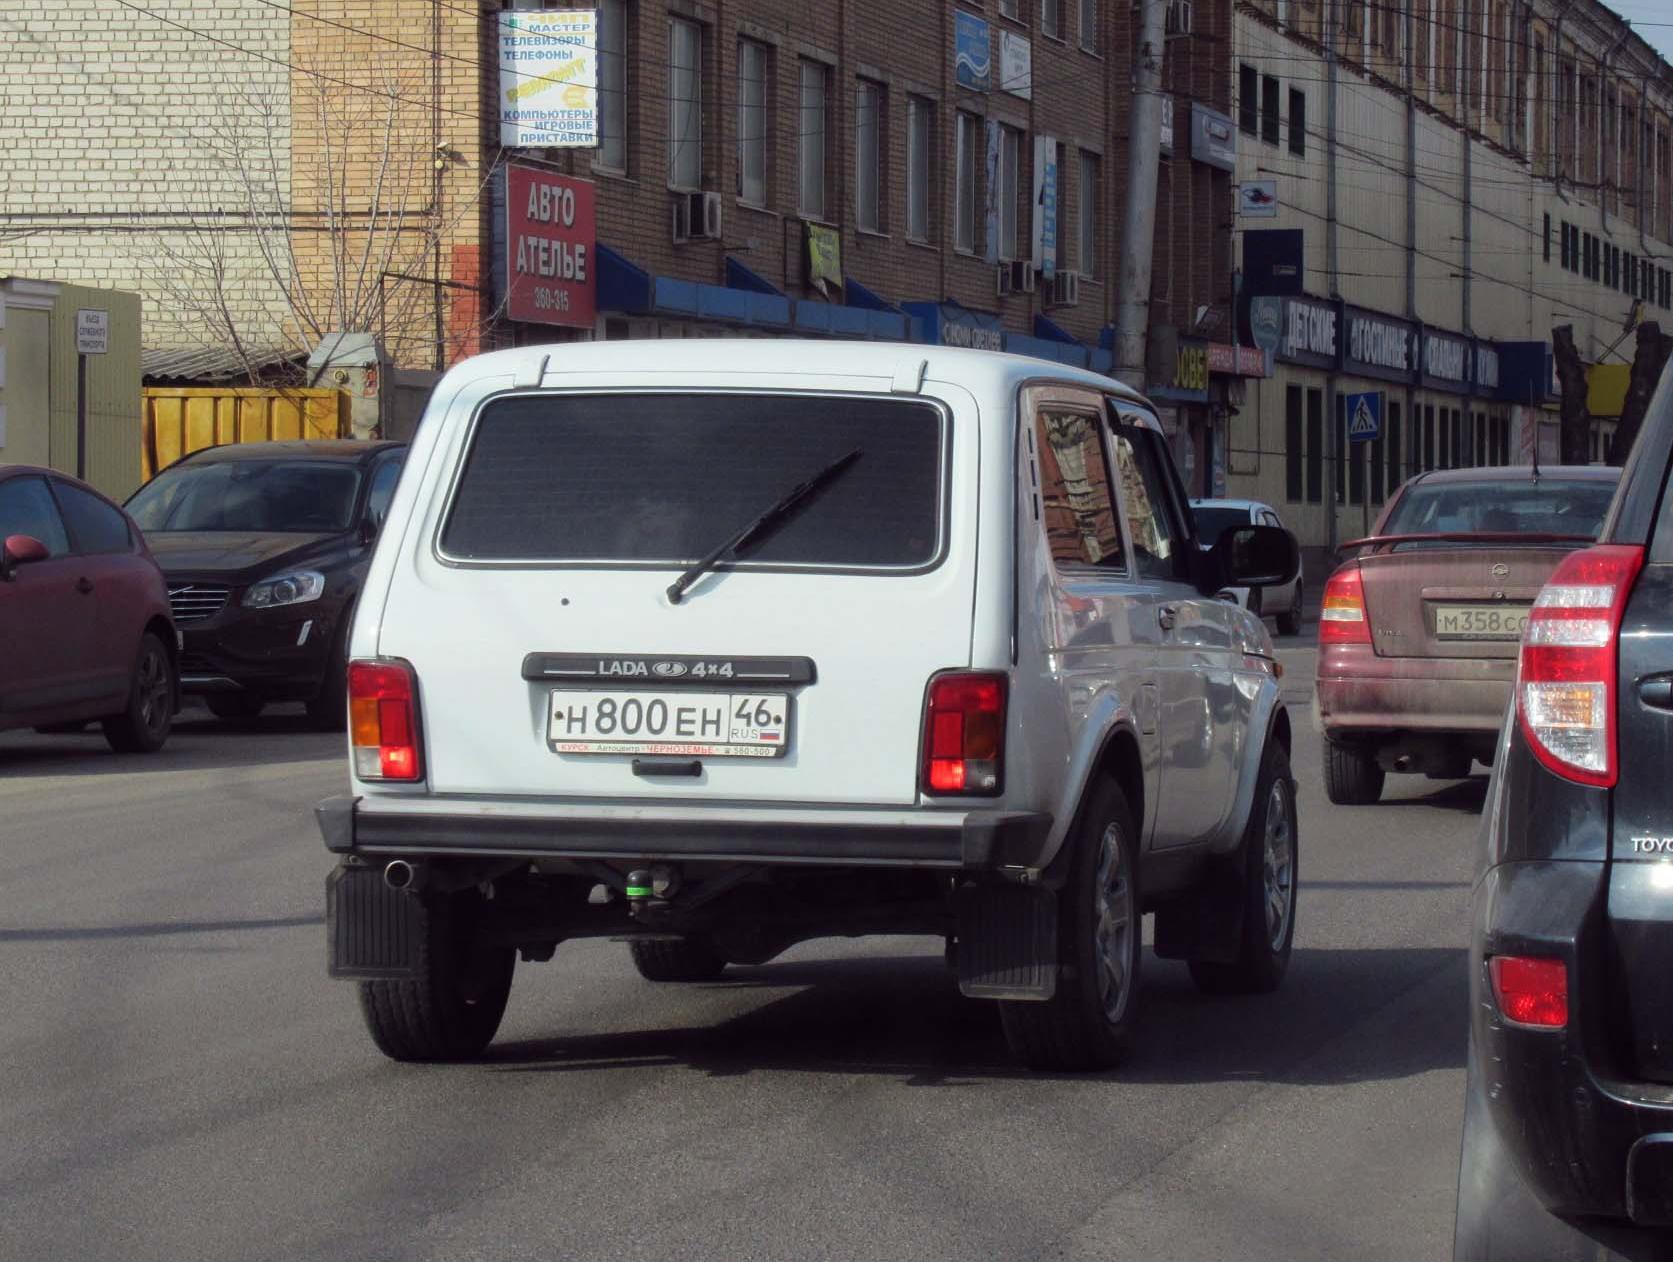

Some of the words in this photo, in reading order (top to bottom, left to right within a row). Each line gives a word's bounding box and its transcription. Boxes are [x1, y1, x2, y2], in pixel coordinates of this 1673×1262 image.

[528, 24, 591, 32] МАСТЕР
[503, 36, 585, 46] ТЕЛЕВИЗОРЫ
[503, 51, 573, 60] ТЕЛЕФОНЫ
[503, 110, 593, 120] КОМПЬЮТЕРЫ
[535, 121, 593, 130] ИГРОВЫЕ
[520, 133, 593, 143] ПРИСТАВКИ
[527, 182, 575, 227] АВТО
[516, 234, 586, 281] АТЕЛЬЕ
[599, 661, 648, 676] LADA
[691, 661, 734, 678] 4x4
[566, 698, 721, 737] Н800ЕН
[735, 698, 772, 728] 46
[731, 729, 758, 739] RUS
[560, 743, 590, 751] КУРСК
